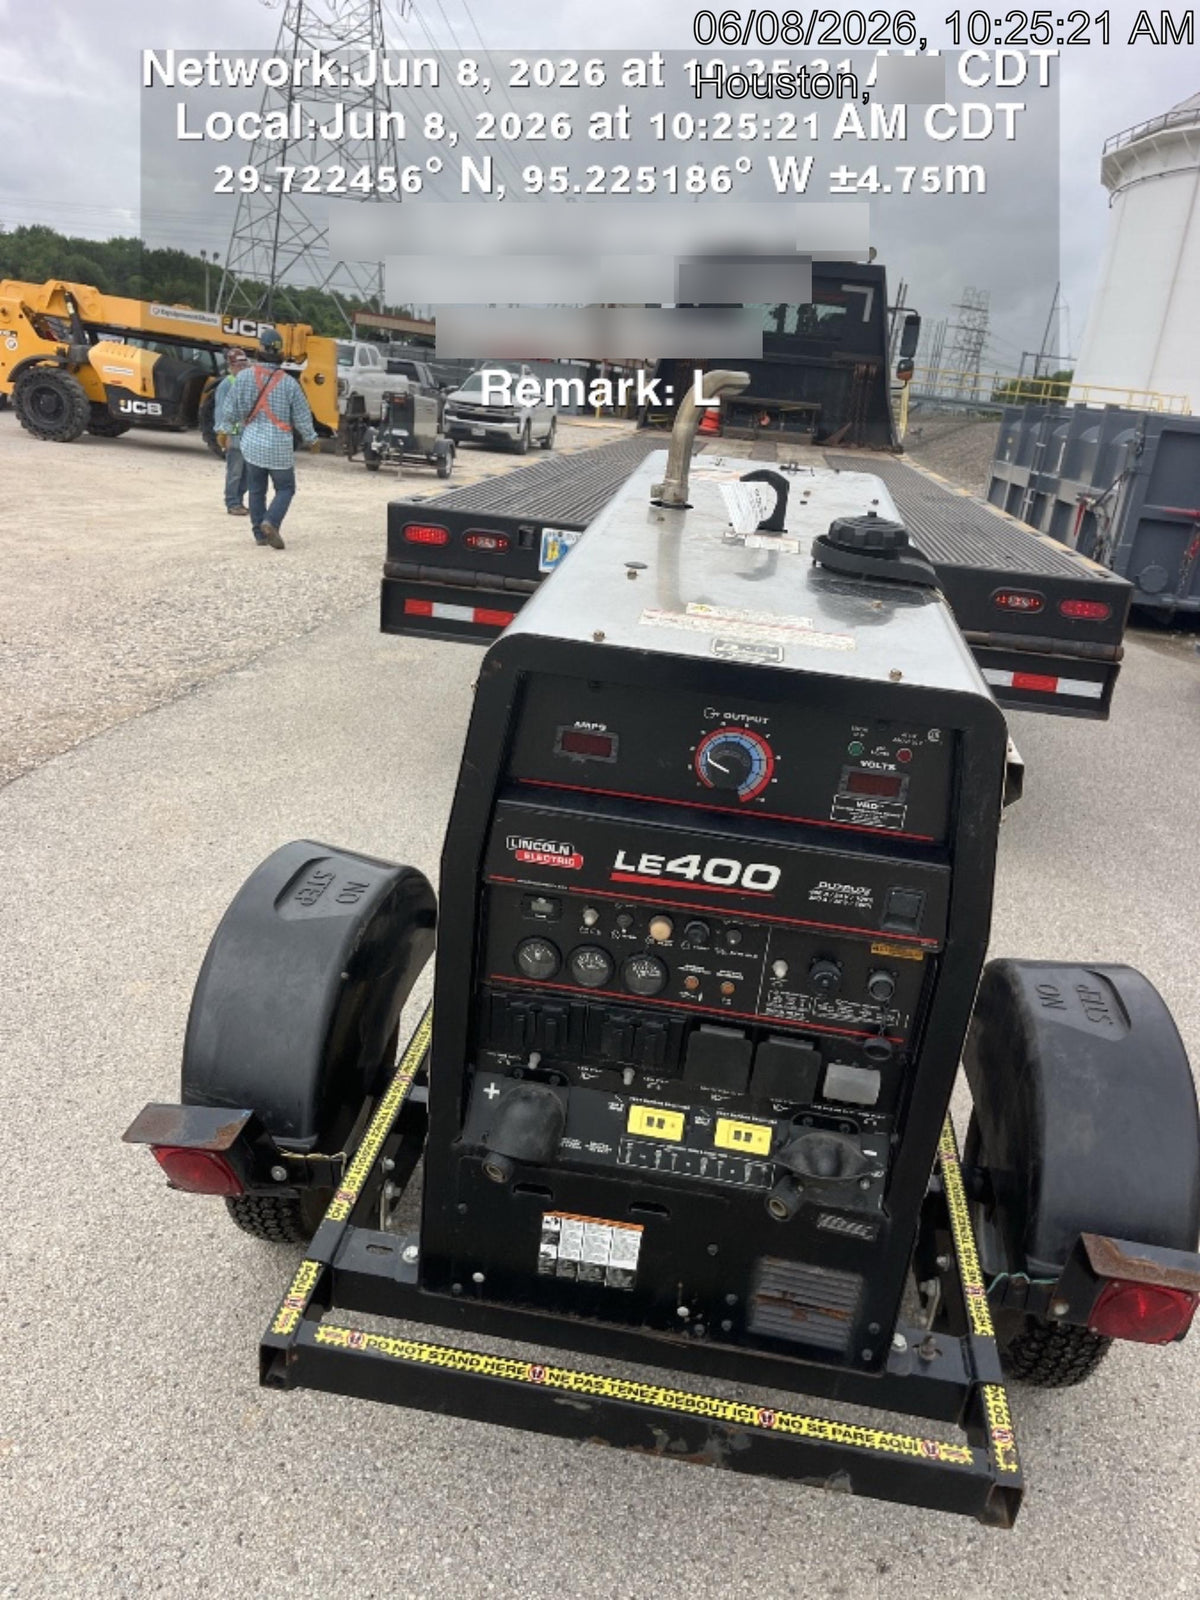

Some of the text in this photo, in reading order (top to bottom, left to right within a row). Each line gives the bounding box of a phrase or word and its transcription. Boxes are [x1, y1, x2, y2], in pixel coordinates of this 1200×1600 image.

[120, 399, 163, 416] JCB
[574, 720, 607, 732] AMPS
[723, 712, 770, 725] OUTPUT
[510, 837, 570, 856] LINCOLN
[523, 851, 575, 868] ELECTRIC
[614, 849, 781, 891] LE400
[295, 870, 336, 907] STEP
[335, 881, 370, 904] NO
[1035, 984, 1067, 1011] NO
[1075, 984, 1114, 1025] STEP
[331, 1202, 345, 1219] NO
[962, 1247, 974, 1267] PAS
[293, 1264, 314, 1295] AQUI
[967, 1268, 977, 1284] NE
[972, 1297, 986, 1327] HERE
[366, 1337, 527, 1375] DO NOT STAND HERE
[547, 1371, 754, 1420] NE PAS TENEZ DEBOUT ICI
[991, 1403, 1006, 1426] DO
[777, 1415, 919, 1451] NO SE PARE AQUI
